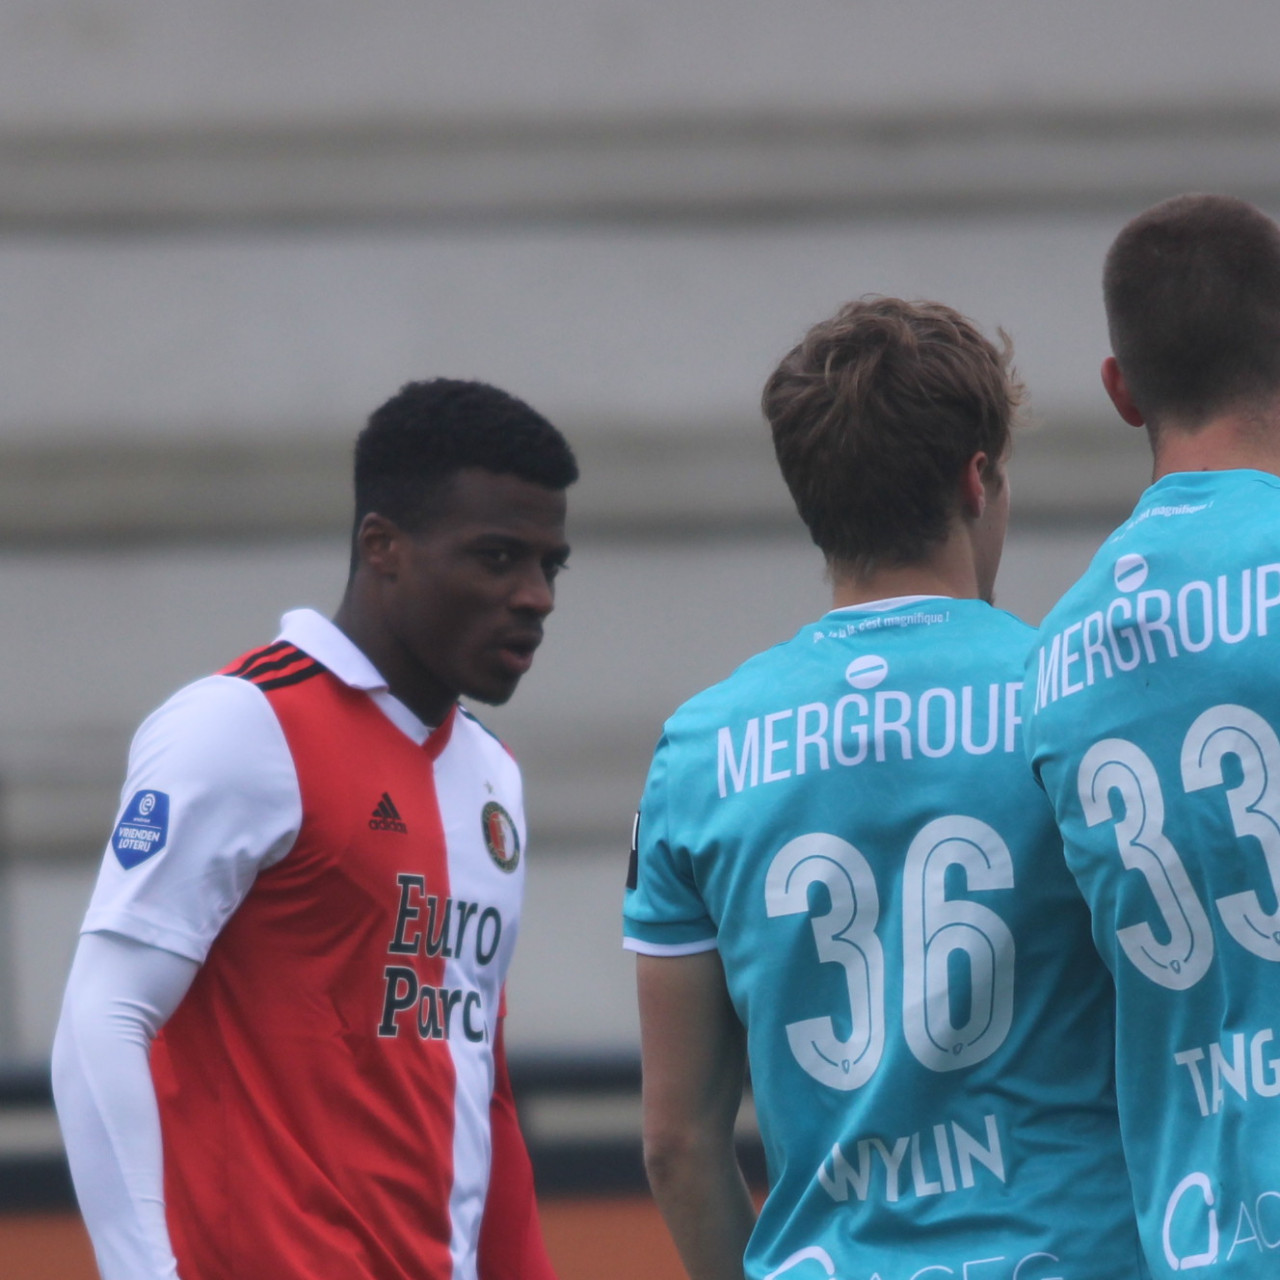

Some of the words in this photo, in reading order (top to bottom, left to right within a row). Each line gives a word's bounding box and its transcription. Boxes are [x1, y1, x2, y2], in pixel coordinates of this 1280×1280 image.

[884, 611, 944, 627] magnifique
[118, 838, 151, 852] LOTERIJ
[119, 827, 161, 842] VRIENDEN
[368, 819, 408, 834] adidas
[387, 872, 503, 966] Euro
[765, 815, 1016, 1091] 36
[377, 964, 489, 1045] Parc
[820, 1114, 1007, 1202] WYLIN
